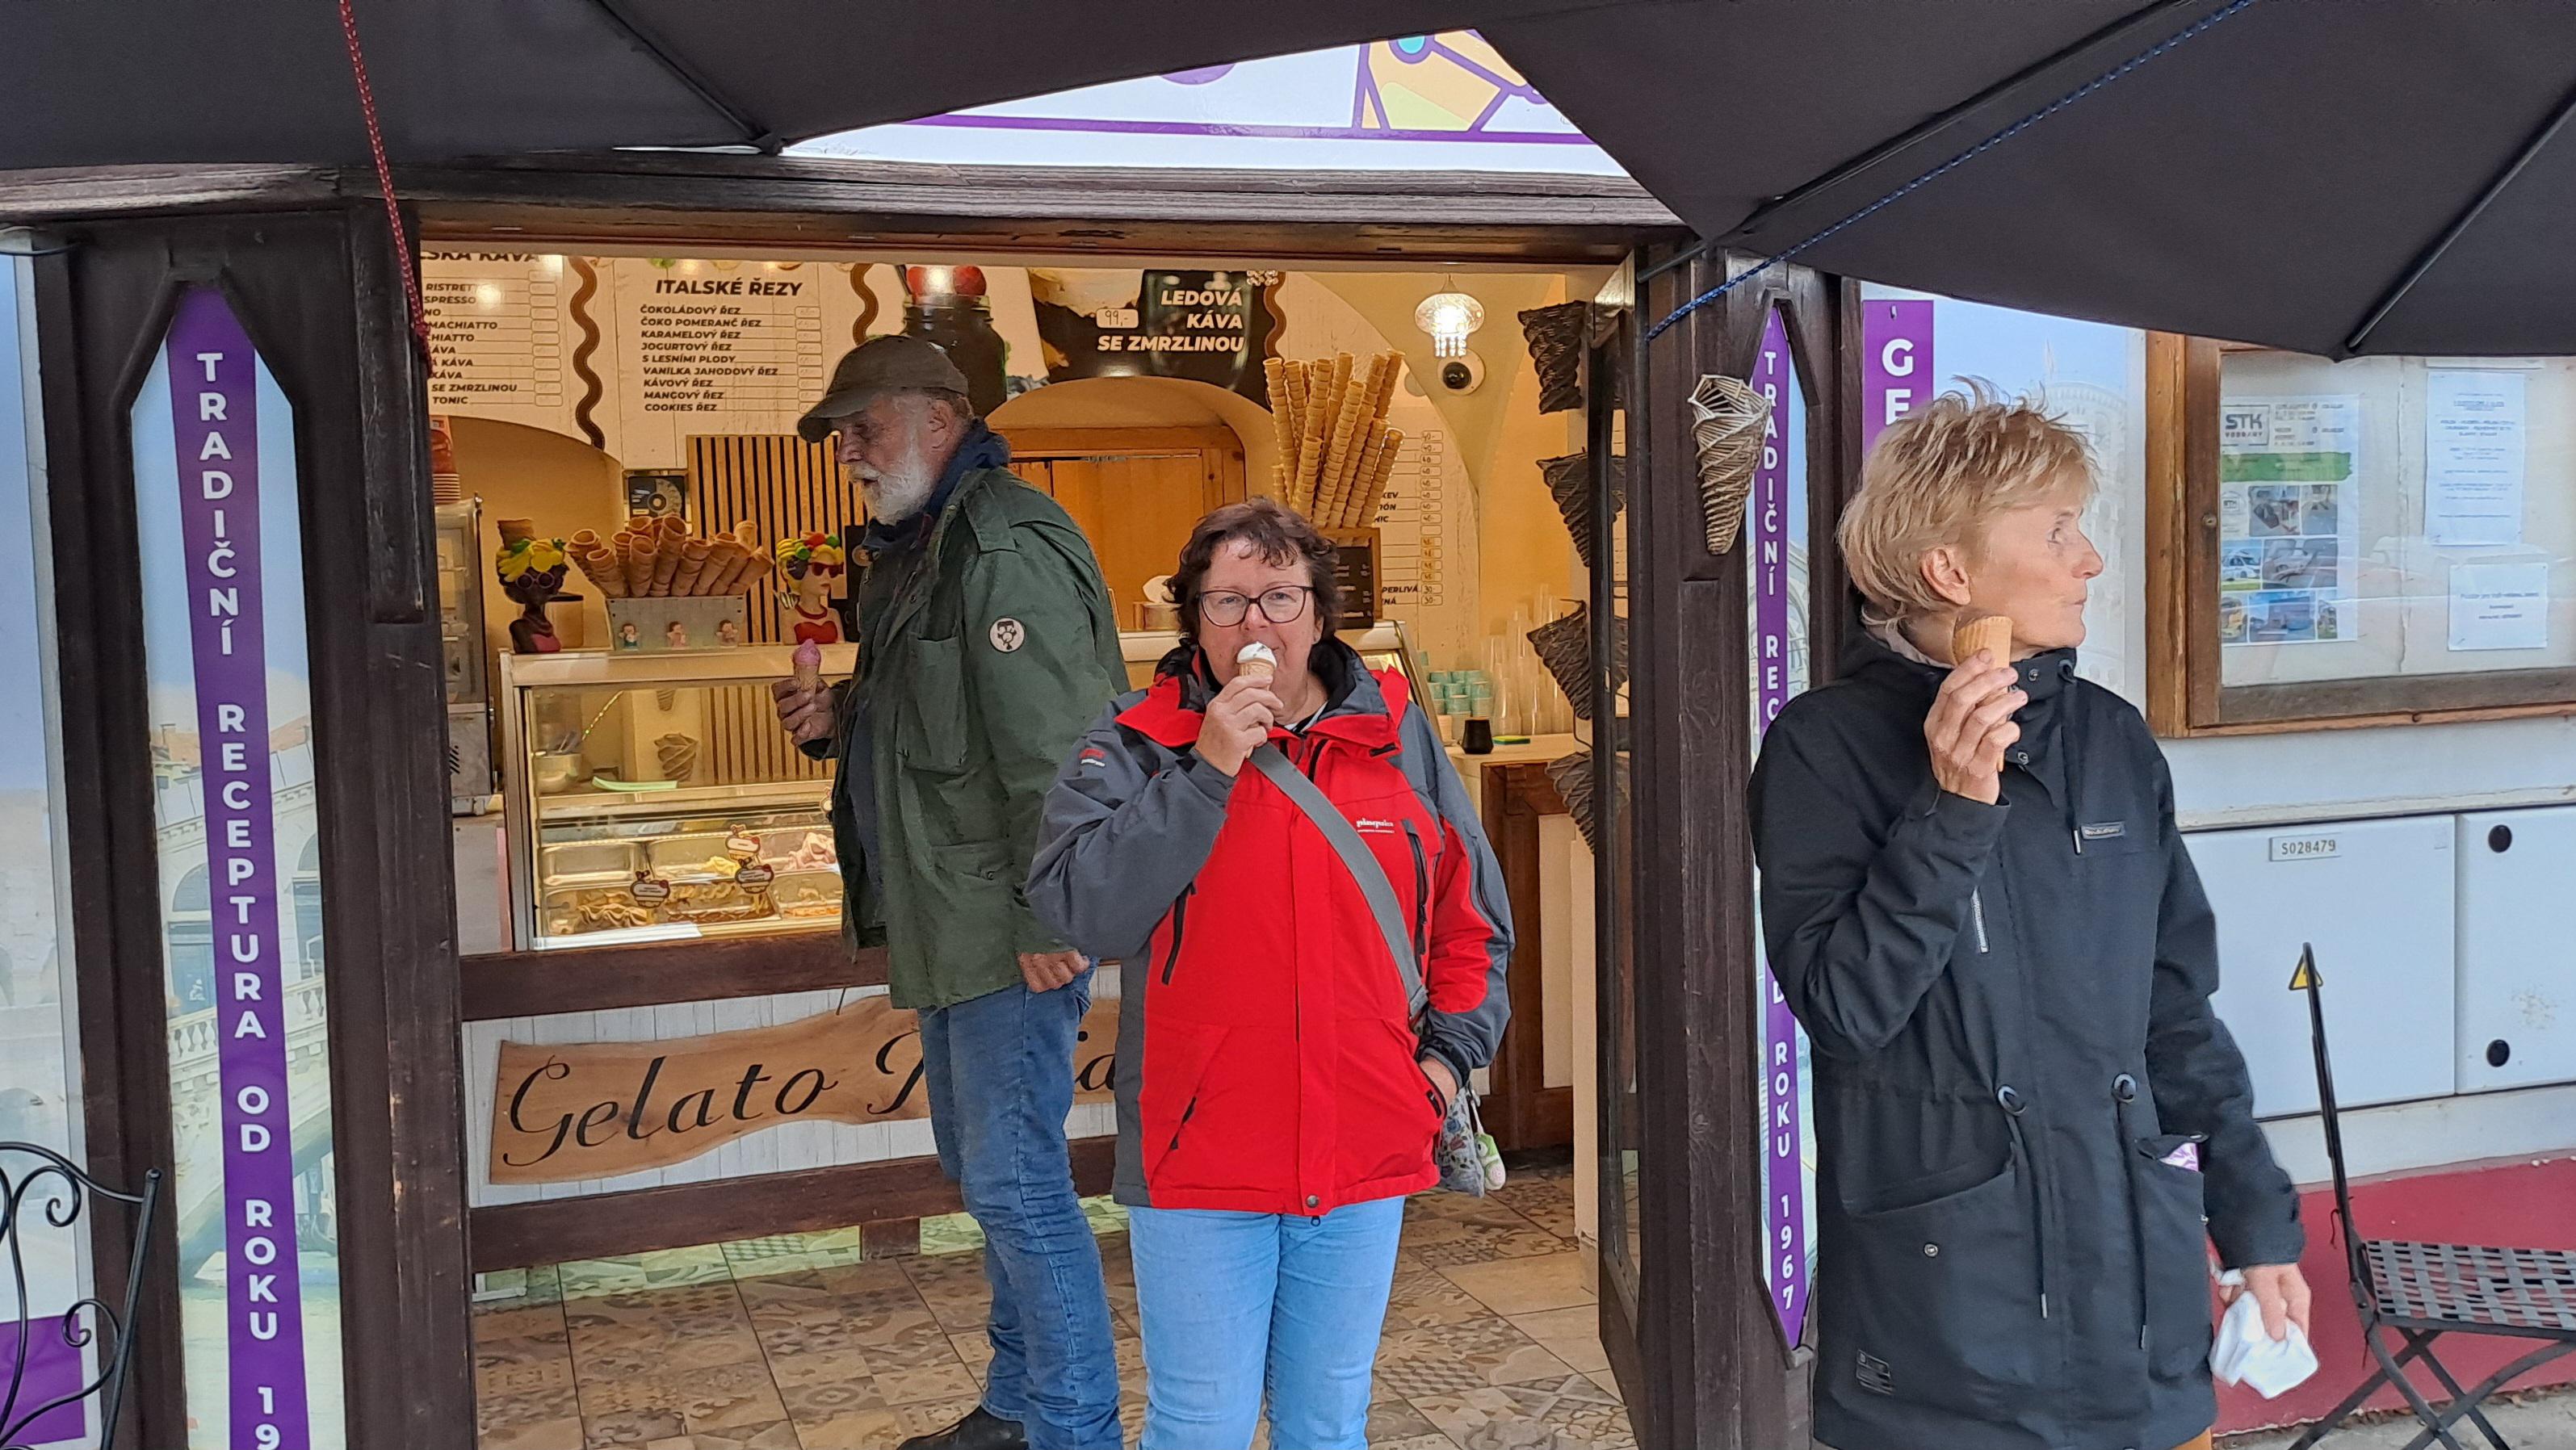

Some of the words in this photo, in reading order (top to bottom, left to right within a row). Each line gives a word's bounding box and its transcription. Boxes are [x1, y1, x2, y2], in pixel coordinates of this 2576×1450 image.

[656, 277, 743, 295] ITALSKÉ
[748, 277, 803, 296] ŘEZY
[1160, 287, 1243, 306] LEDOVÁ
[640, 304, 717, 315] ČOKOLÁDOVÝ
[720, 304, 741, 316] ŘEZ
[640, 316, 673, 326] ČOKO
[675, 317, 737, 327] POMERANČ
[740, 318, 761, 328] ŘEZ
[1186, 310, 1243, 329] KÁVA
[641, 329, 717, 339] KARAMELOVÝ
[720, 329, 741, 340] ŘEZ
[430, 345, 456, 354] ÁVA
[641, 341, 707, 351] JOGURTOVÝ
[711, 342, 732, 351] ŘEZ
[1097, 335, 1123, 352] SE
[1127, 336, 1244, 352] ZMRZLINOU
[441, 358, 473, 367] KÁVA
[642, 354, 649, 363] S
[652, 353, 696, 363] LESNÍMI
[699, 355, 736, 363] PLODY
[643, 367, 691, 375] VANILKA
[694, 366, 755, 376] JAHODOVÝ
[757, 367, 778, 376] ŘEZ
[432, 383, 445, 392] SE
[448, 383, 518, 392] ZMRZLINOU
[643, 377, 689, 388] KÁVOVÝ
[691, 378, 713, 388] ŘEZ
[644, 389, 700, 400] MANGOVÝ
[703, 390, 724, 400] ŘEZ
[644, 403, 693, 412] COOKIES
[695, 402, 717, 412] ŘEZ
[2225, 413, 2262, 430] STK
[1764, 351, 1778, 596] TRADIČNÍ
[196, 351, 240, 656] TRADIČNÍ
[2280, 839, 2336, 856] S028479
[217, 704, 266, 1039] RECEPTURA
[1774, 1041, 1791, 1159] ROKU
[237, 1085, 271, 1153] OD
[502, 1054, 839, 1167] Gelato
[1781, 1195, 1795, 1310] 1967
[244, 1199, 279, 1341] ROKU
